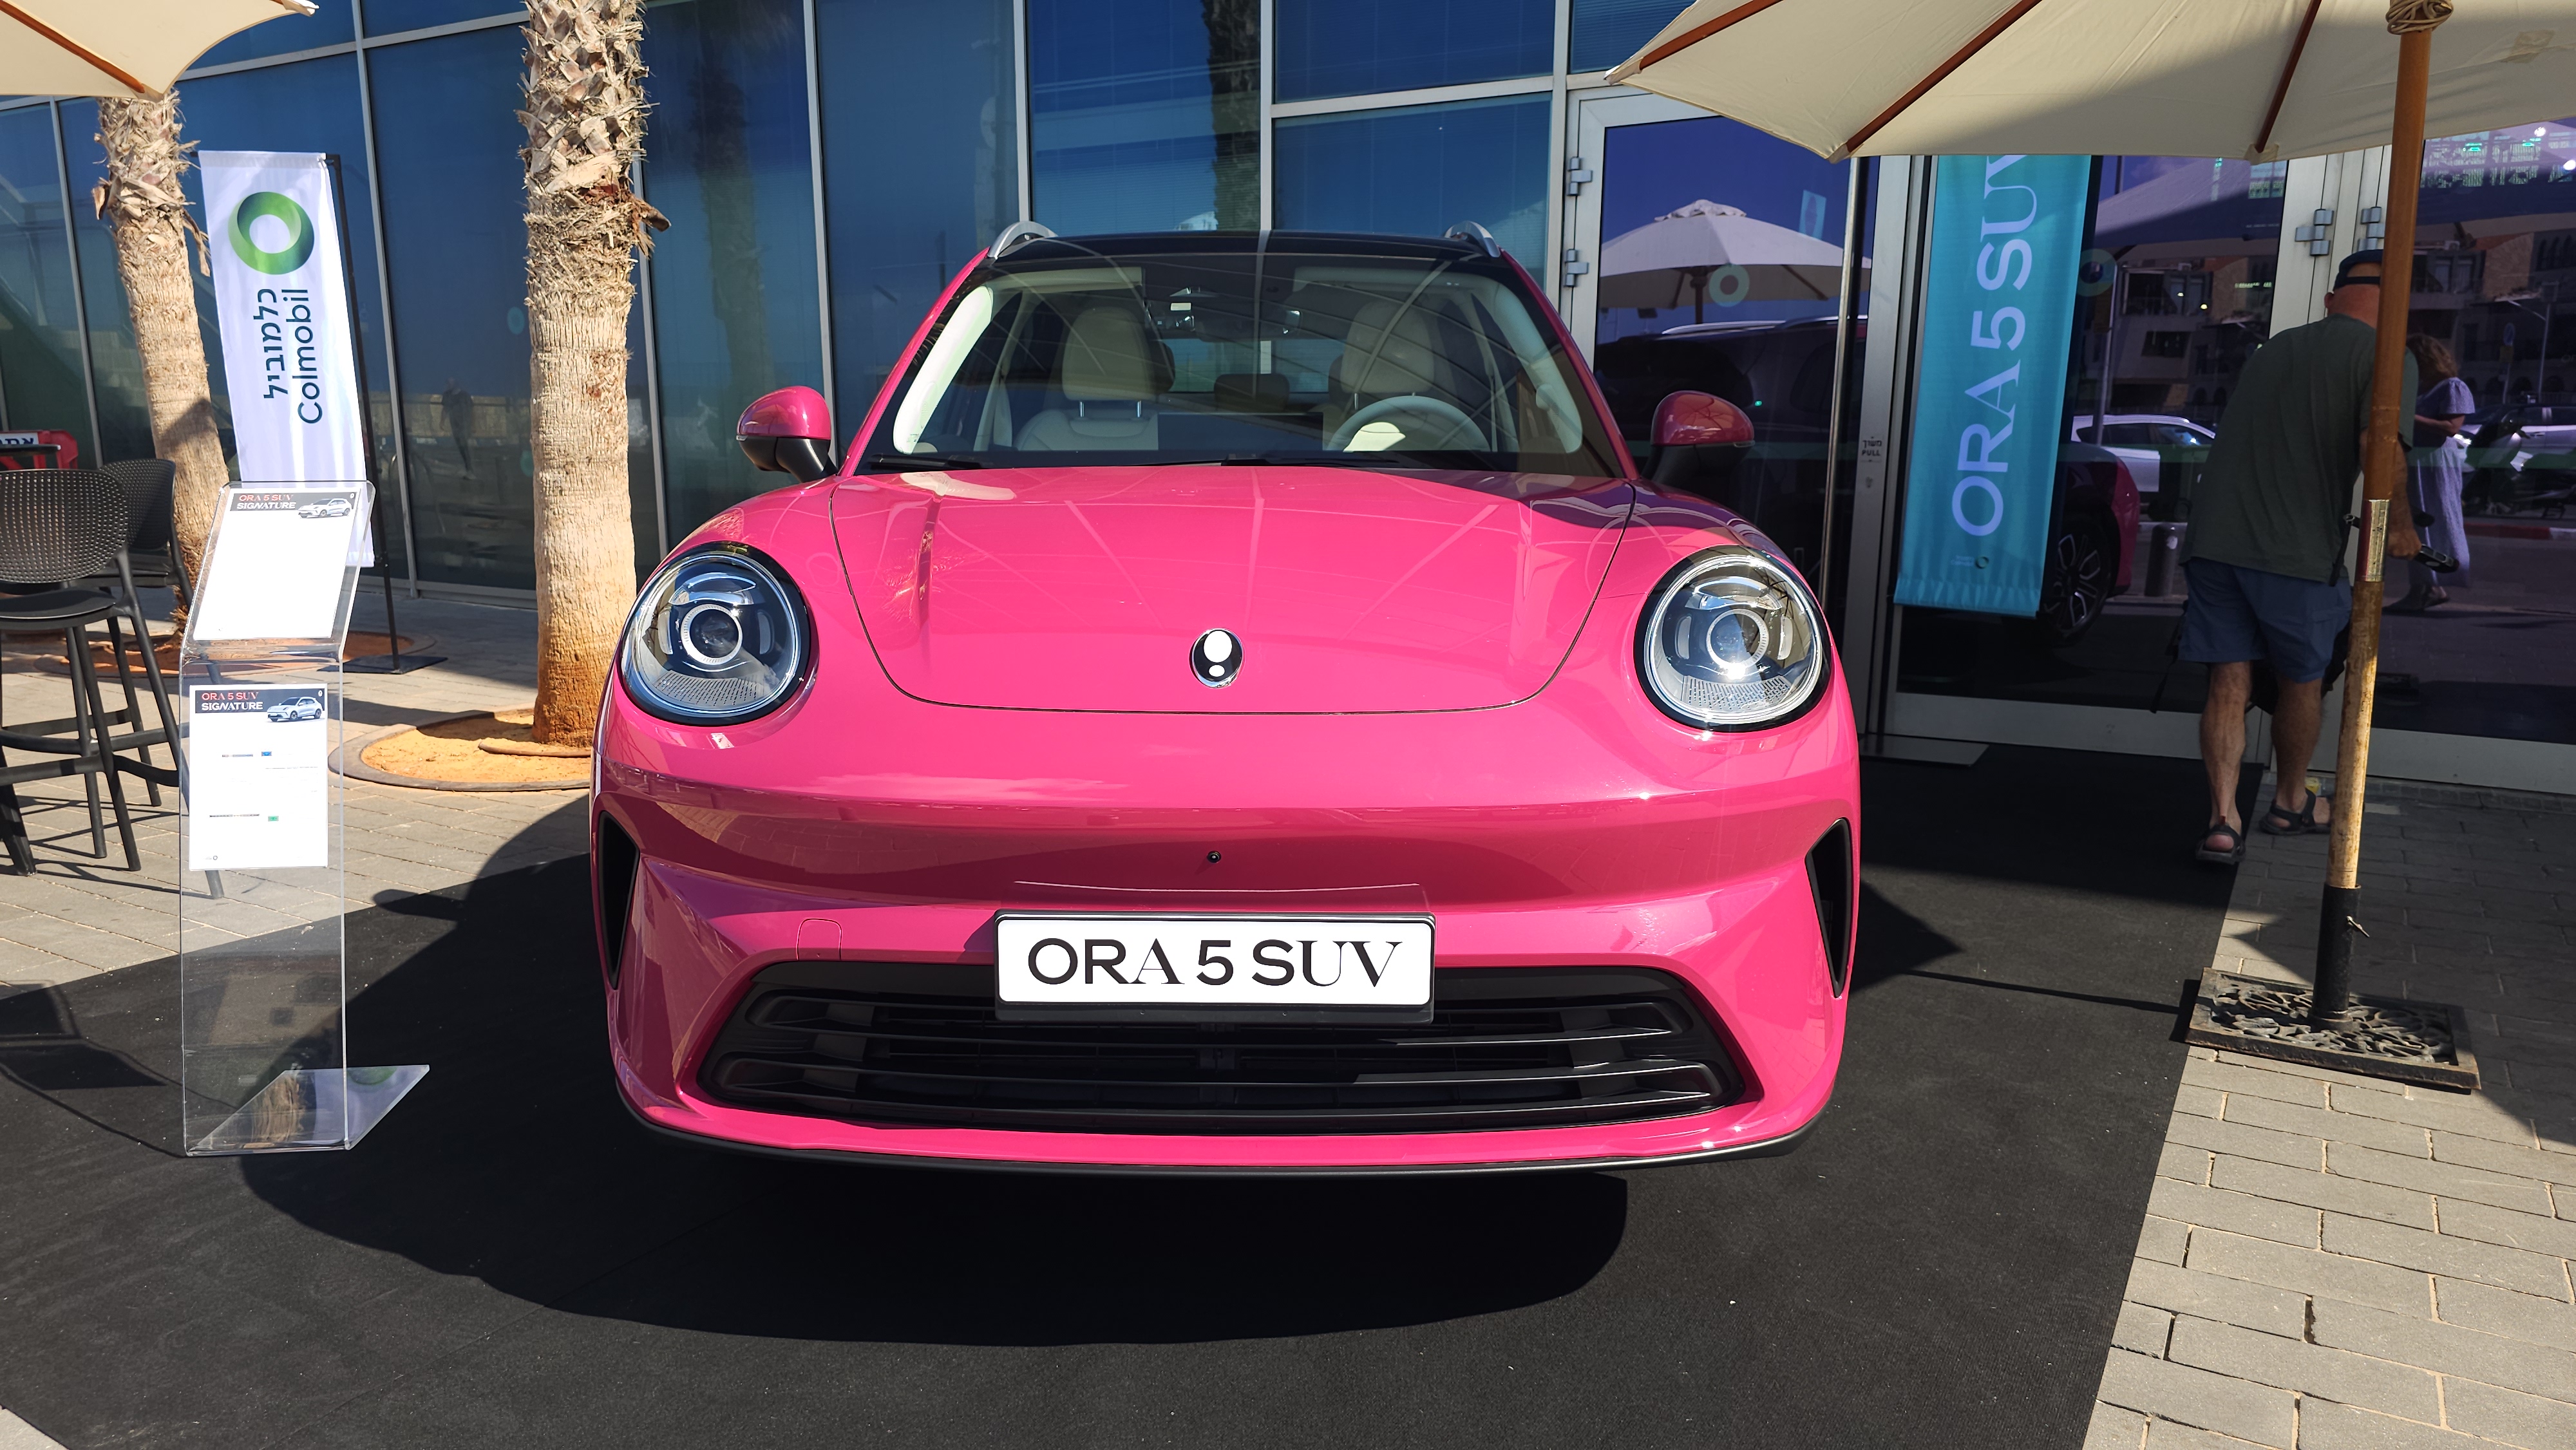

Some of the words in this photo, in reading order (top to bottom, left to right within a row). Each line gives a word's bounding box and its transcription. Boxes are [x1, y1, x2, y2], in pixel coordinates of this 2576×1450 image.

[253, 288, 289, 399] כלמוביל
[1971, 306, 2026, 351] 5
[281, 289, 323, 424] Colmobil
[1952, 359, 2021, 536] ORA
[202, 692, 225, 701] ORA
[236, 692, 259, 700] SUV
[202, 701, 263, 711] SIGNATURE
[1028, 937, 1185, 985] ORA
[1196, 939, 1234, 986] 5
[1251, 939, 1403, 988] SUV
